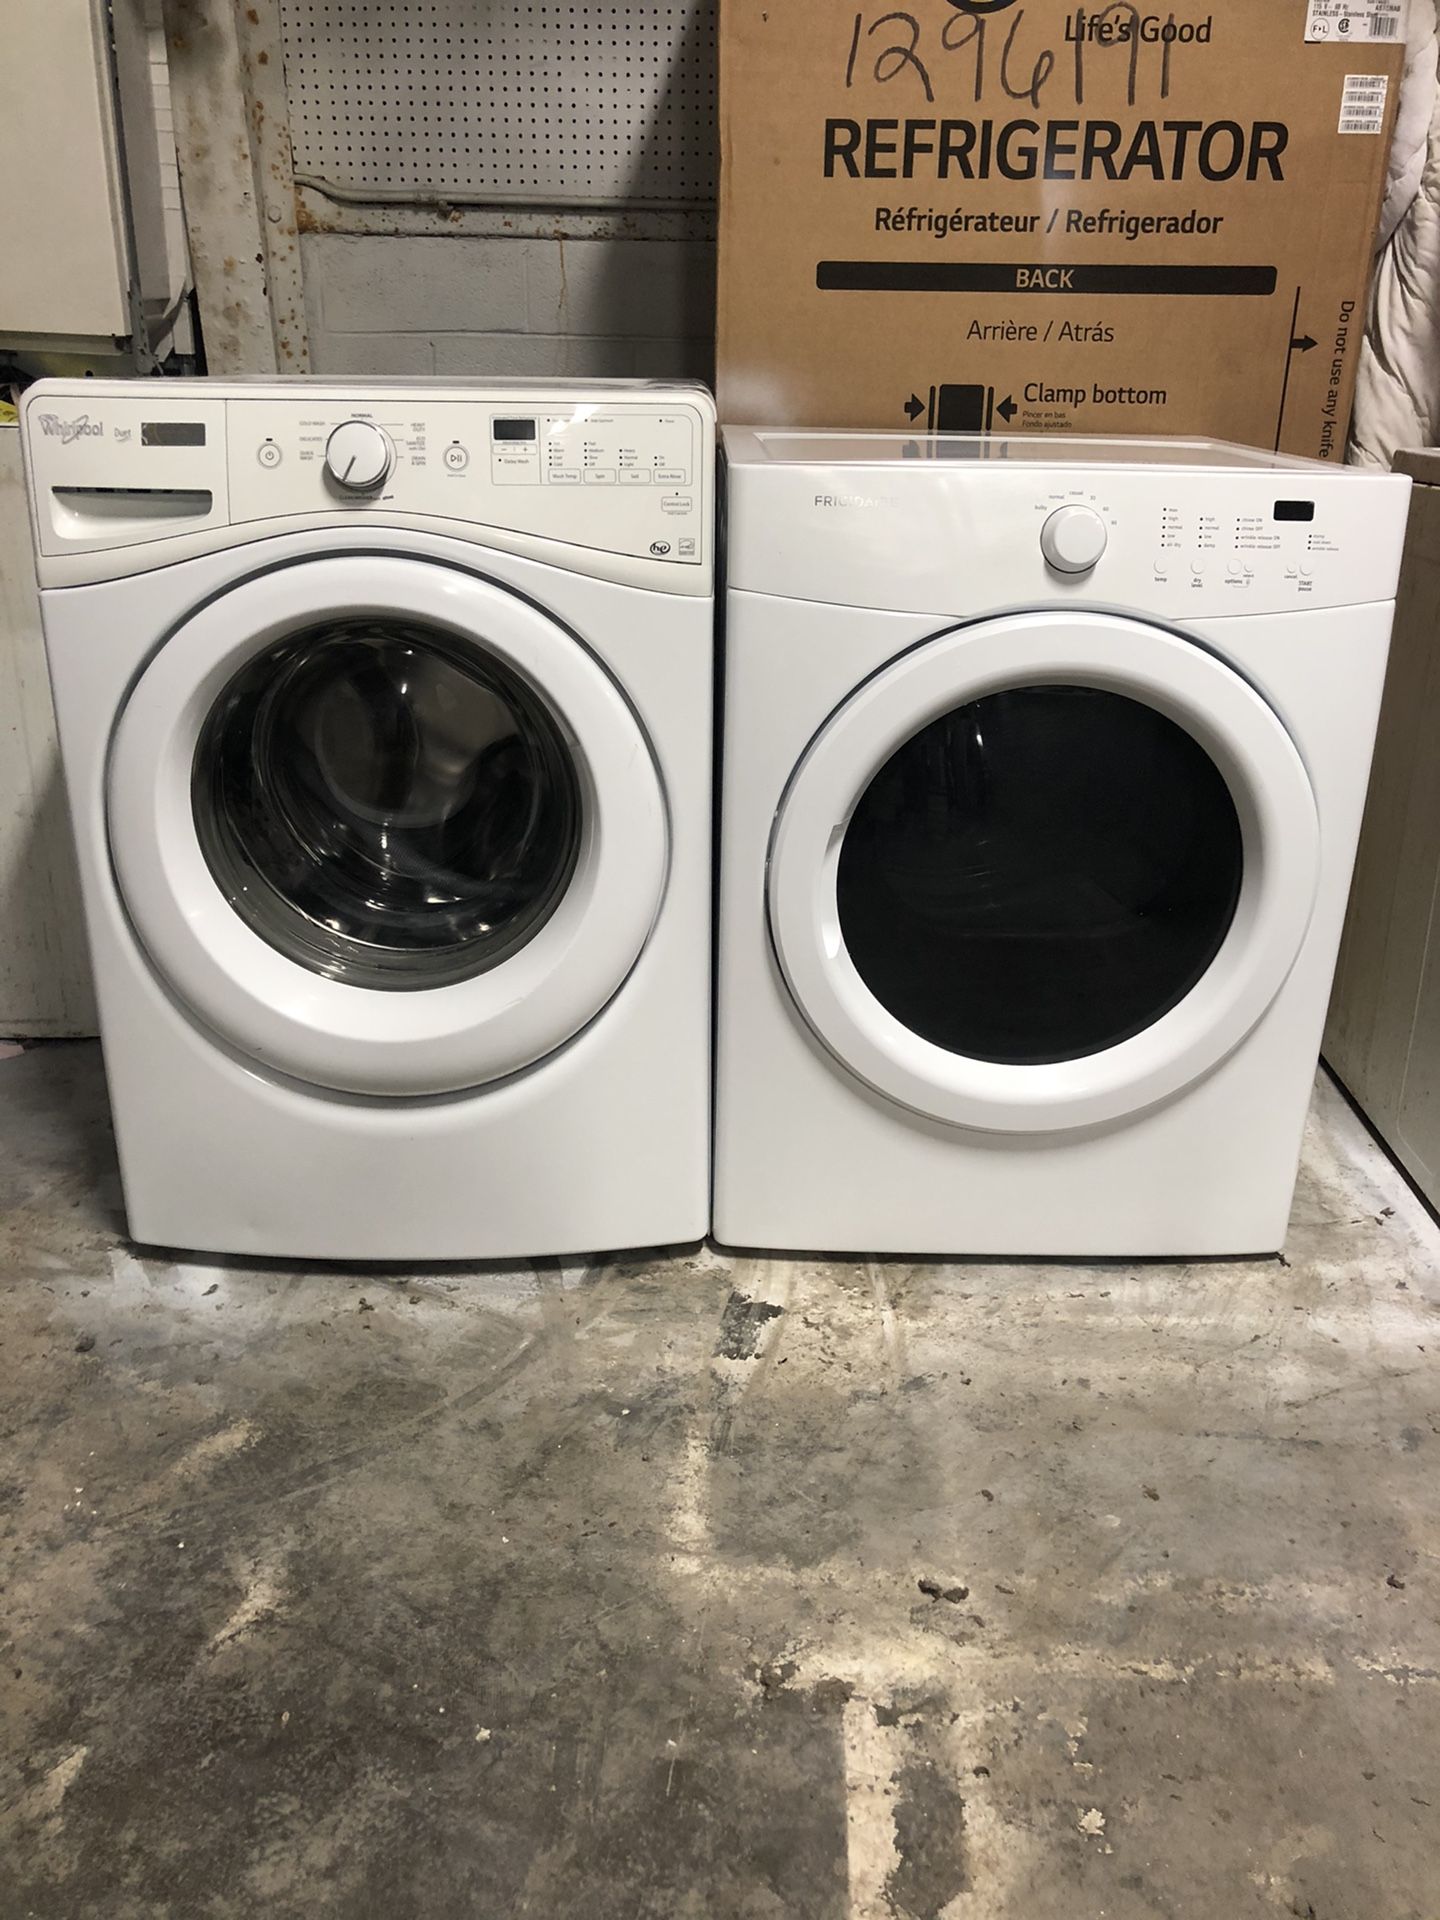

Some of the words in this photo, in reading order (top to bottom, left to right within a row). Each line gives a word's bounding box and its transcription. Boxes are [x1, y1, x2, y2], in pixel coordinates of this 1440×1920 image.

[1064, 14, 1132, 43] Life's
[1140, 15, 1213, 43] Good
[846, 1, 1175, 109] 1296191
[823, 118, 1290, 182] REFRIGERATOR
[874, 207, 1040, 239] Réfrigérateur
[1046, 209, 1058, 233] /
[1065, 209, 1224, 240] Refrigerador
[1015, 268, 1075, 289] BACK
[1339, 301, 1356, 323] Do
[966, 319, 1038, 341] Arrière
[1043, 320, 1054, 342] /
[1058, 321, 1115, 342] Atrás
[1333, 327, 1349, 354] not
[1329, 358, 1343, 386] use
[1023, 382, 1087, 408] Clamp
[1092, 384, 1168, 405] bottom
[1321, 389, 1338, 417] any
[38, 414, 104, 443] Whirlpool
[1318, 421, 1337, 458] knife
